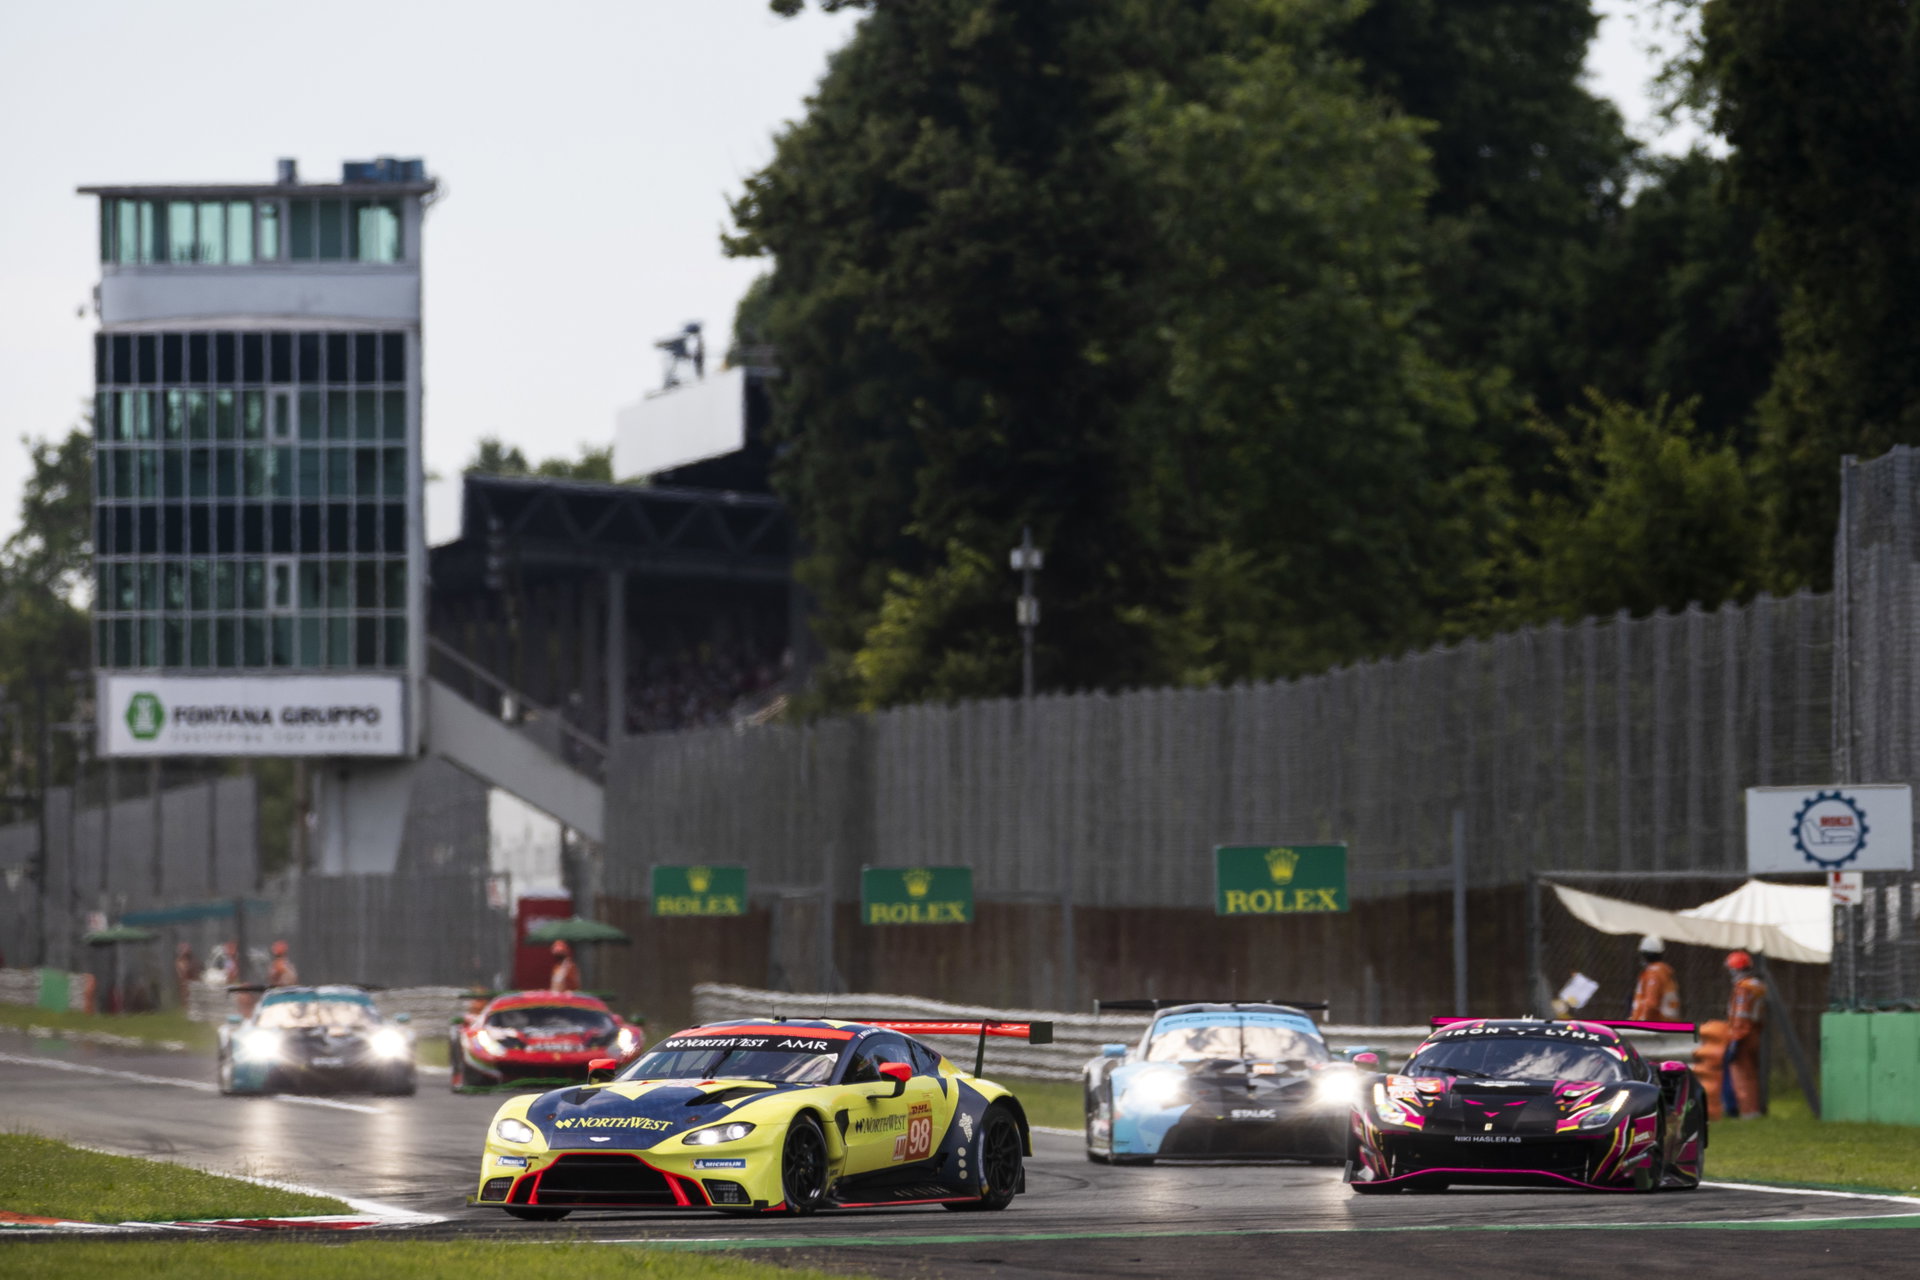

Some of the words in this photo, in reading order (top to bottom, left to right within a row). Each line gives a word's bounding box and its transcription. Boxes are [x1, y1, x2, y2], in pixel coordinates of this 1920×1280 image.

[172, 705, 273, 727] FONTANA
[280, 704, 381, 727] GRUPPO
[656, 896, 740, 916] ROLEX
[1225, 888, 1339, 914] ROLEX
[869, 902, 966, 924] ROLEX
[777, 1039, 828, 1050] AMR
[1446, 1027, 1500, 1037] IRON
[1545, 1029, 1601, 1042] LYNX
[910, 1104, 928, 1115] DHL
[909, 1118, 931, 1154] 98
